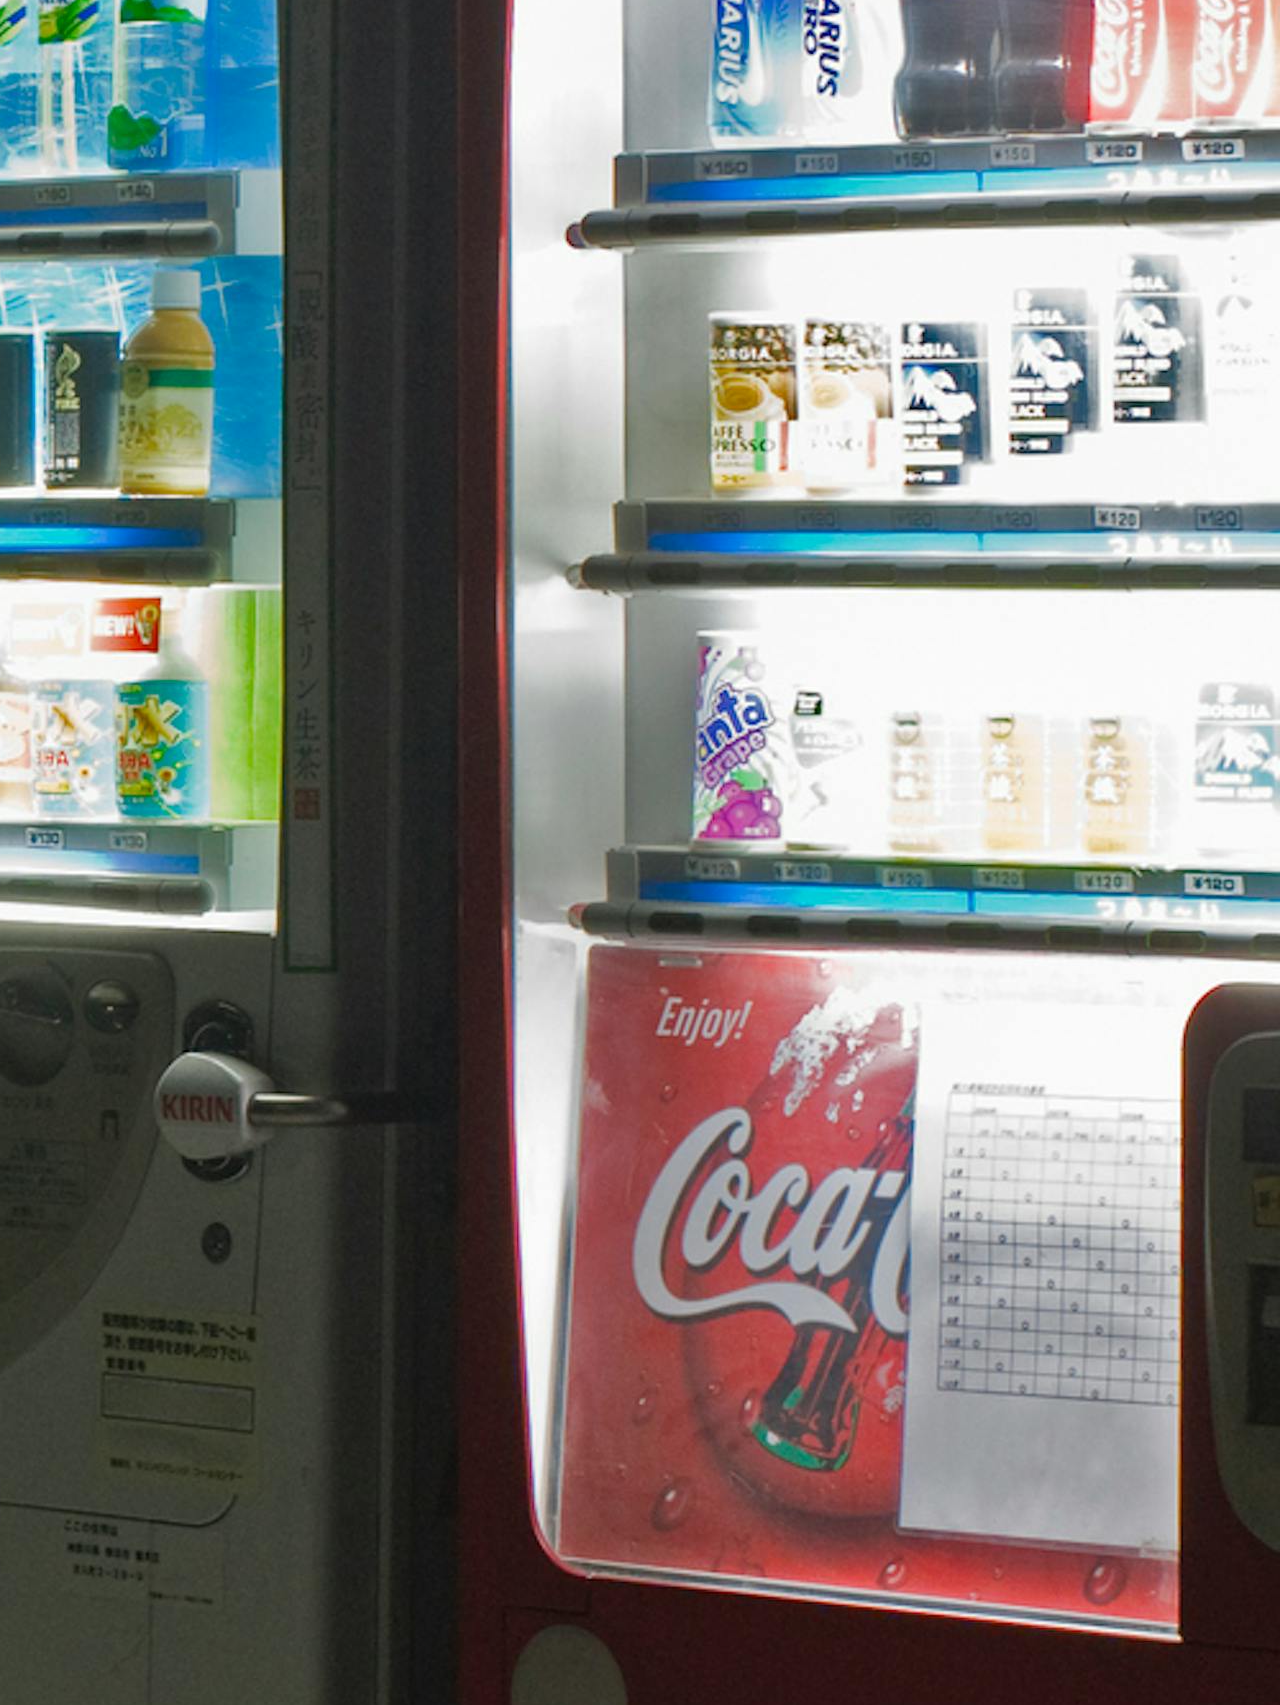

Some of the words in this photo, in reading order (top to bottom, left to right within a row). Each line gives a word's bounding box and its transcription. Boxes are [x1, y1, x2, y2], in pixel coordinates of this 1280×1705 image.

[994, 144, 1030, 159] ¥150
[1094, 144, 1137, 158] ¥120
[1192, 142, 1235, 156] ¥120
[799, 157, 836, 170] ¥150
[1098, 510, 1138, 527] ¥120
[1199, 509, 1238, 527] ¥120
[700, 729, 768, 792] Grape
[1084, 873, 1122, 889] ¥120
[1193, 876, 1235, 891] ¥120
[655, 995, 754, 1048] Enjoy!
[160, 1091, 236, 1125] KIRIN
